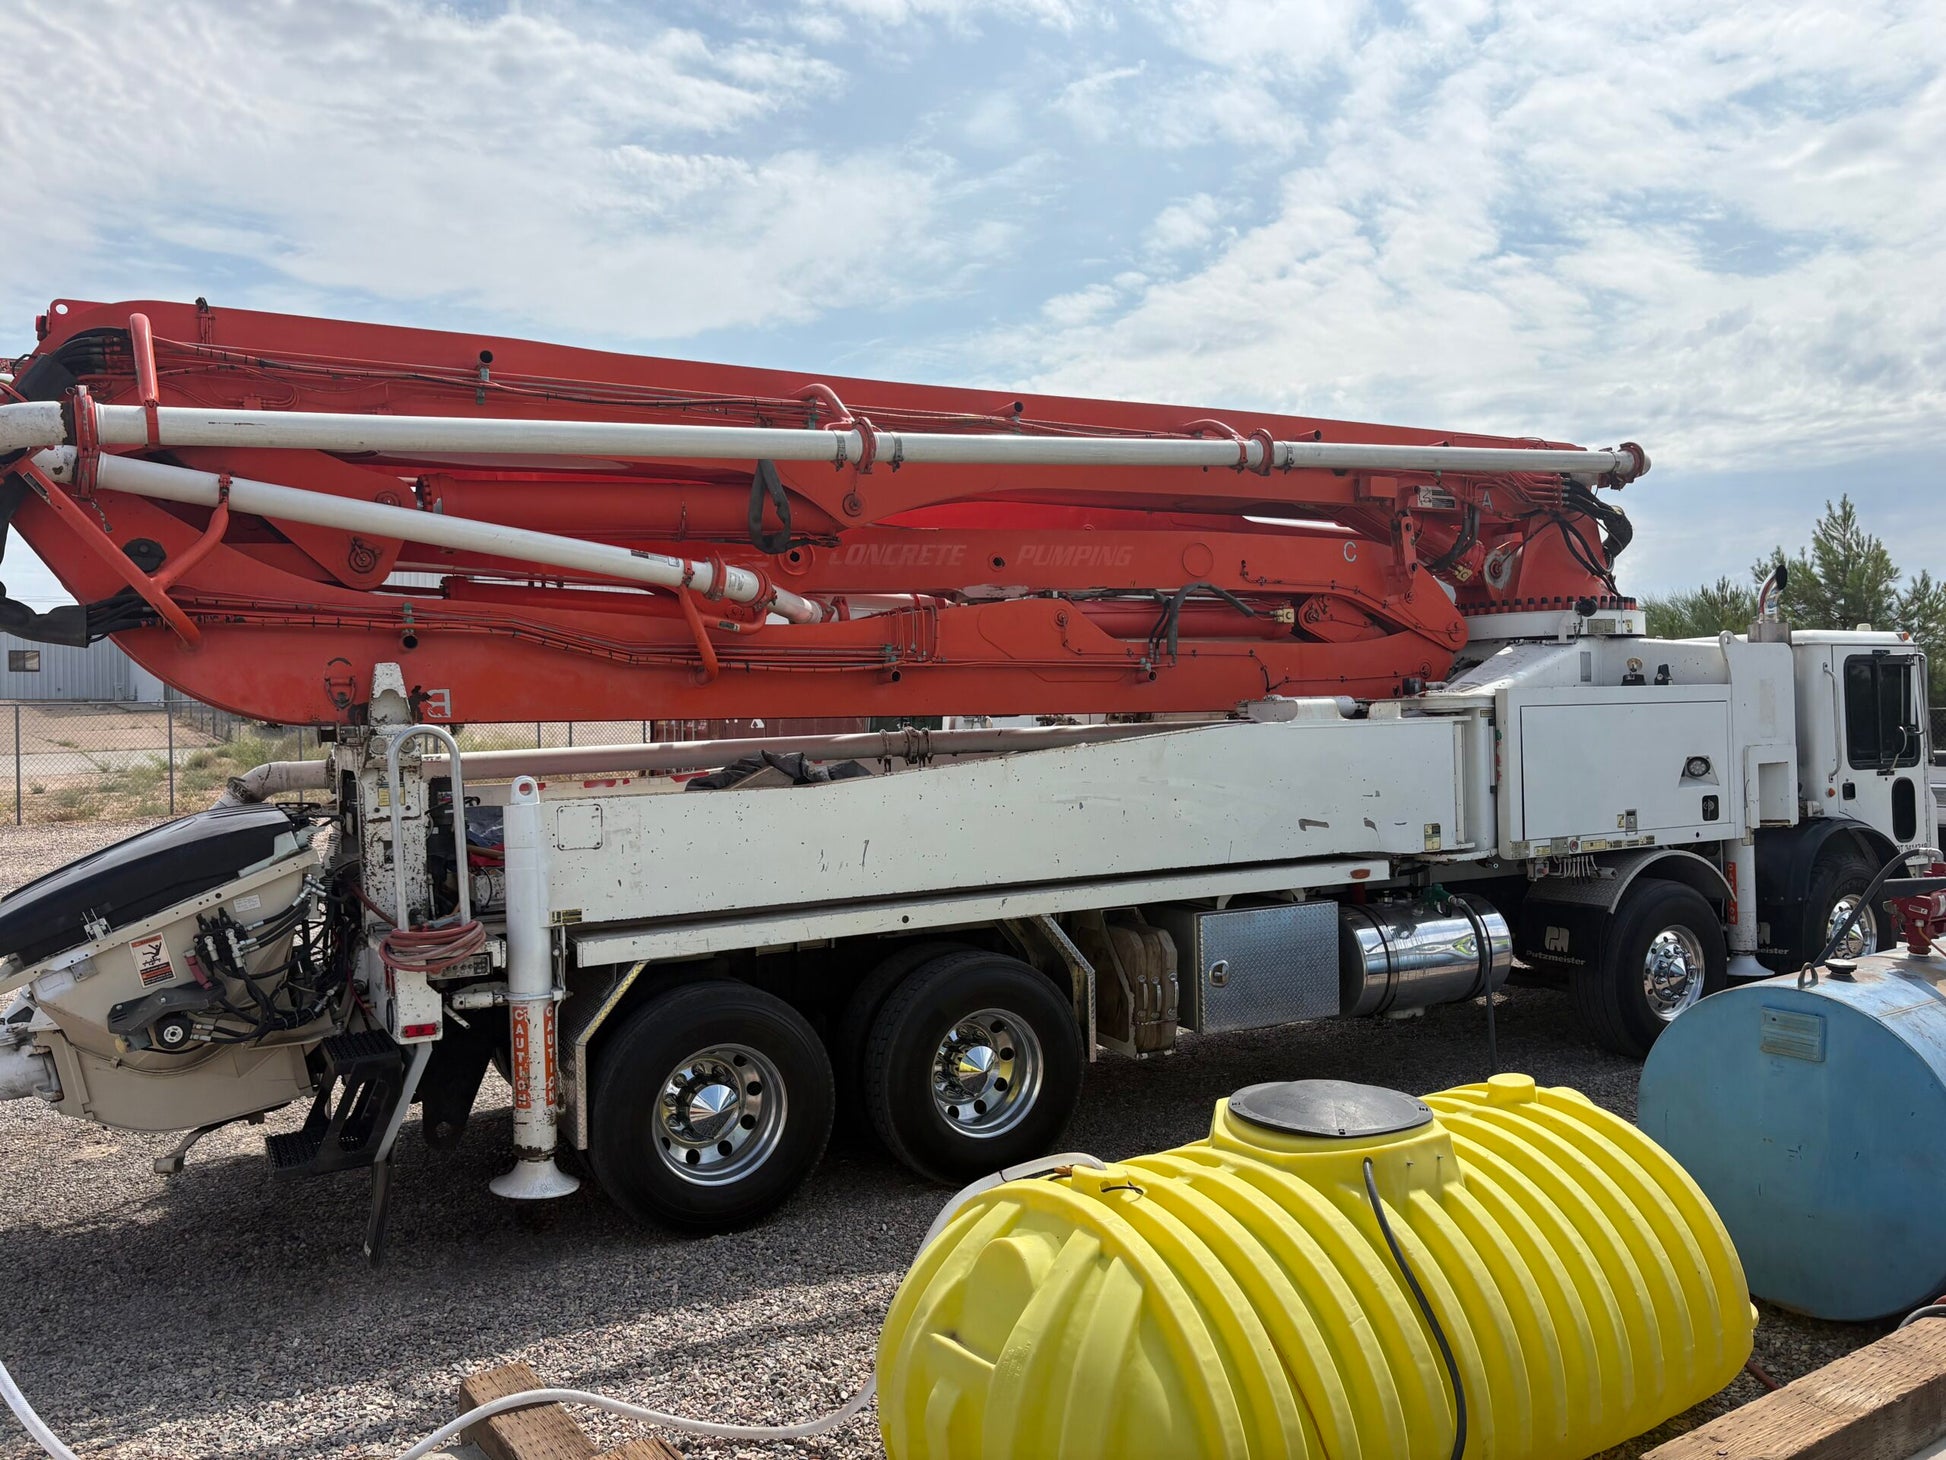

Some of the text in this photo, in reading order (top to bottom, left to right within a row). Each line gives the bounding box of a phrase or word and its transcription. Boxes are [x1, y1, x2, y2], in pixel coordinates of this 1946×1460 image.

[1482, 490, 1494, 512] A
[1016, 544, 1134, 567] PUMPING
[1344, 541, 1357, 562] C
[1526, 950, 1586, 966] Putzmeister
[514, 1009, 527, 1105] CAUTION
[546, 1006, 555, 1102] CAUTION
